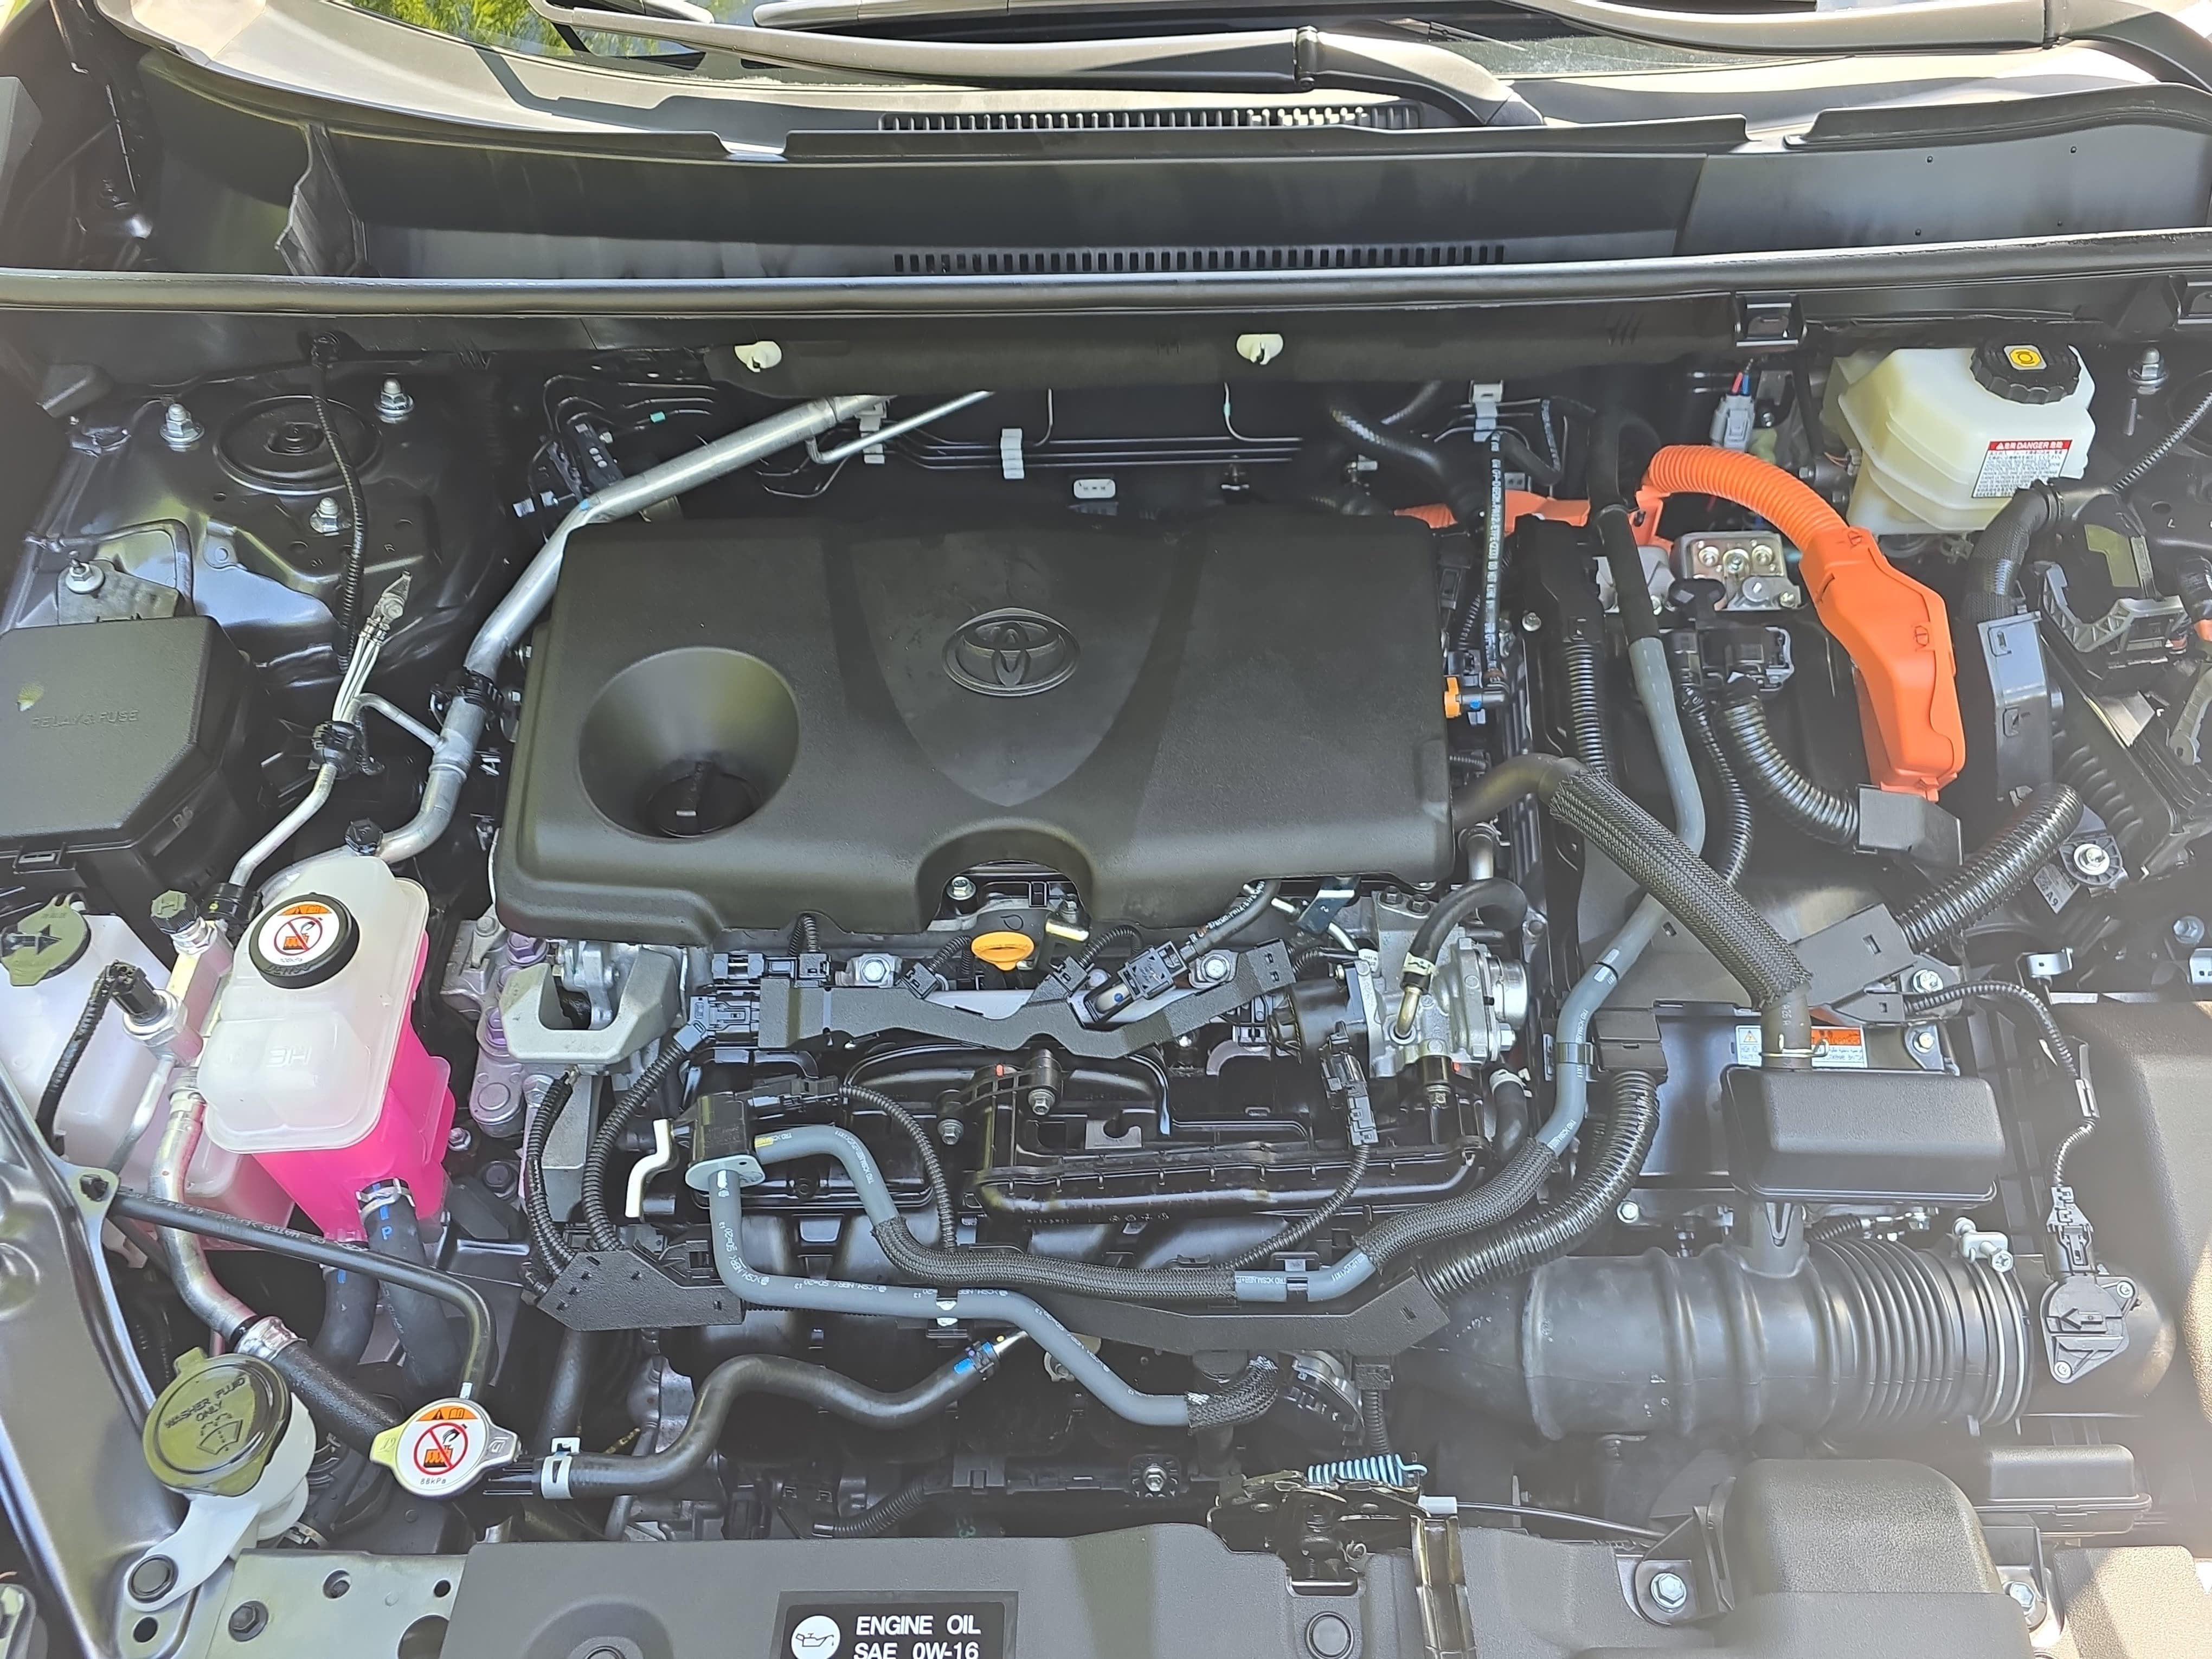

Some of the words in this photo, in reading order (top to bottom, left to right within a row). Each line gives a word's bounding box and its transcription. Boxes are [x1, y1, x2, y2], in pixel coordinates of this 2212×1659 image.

[2016, 441, 2049, 449] DANGER
[99, 710, 139, 724] FUSE
[165, 1398, 211, 1428] WASHER
[196, 1400, 222, 1422] ONLY
[420, 1477, 446, 1485] 88kPa
[856, 1615, 934, 1636] ENGINE
[946, 1615, 981, 1635] OIL
[853, 1642, 898, 1659] SAE
[912, 1642, 979, 1659] 0W-16
